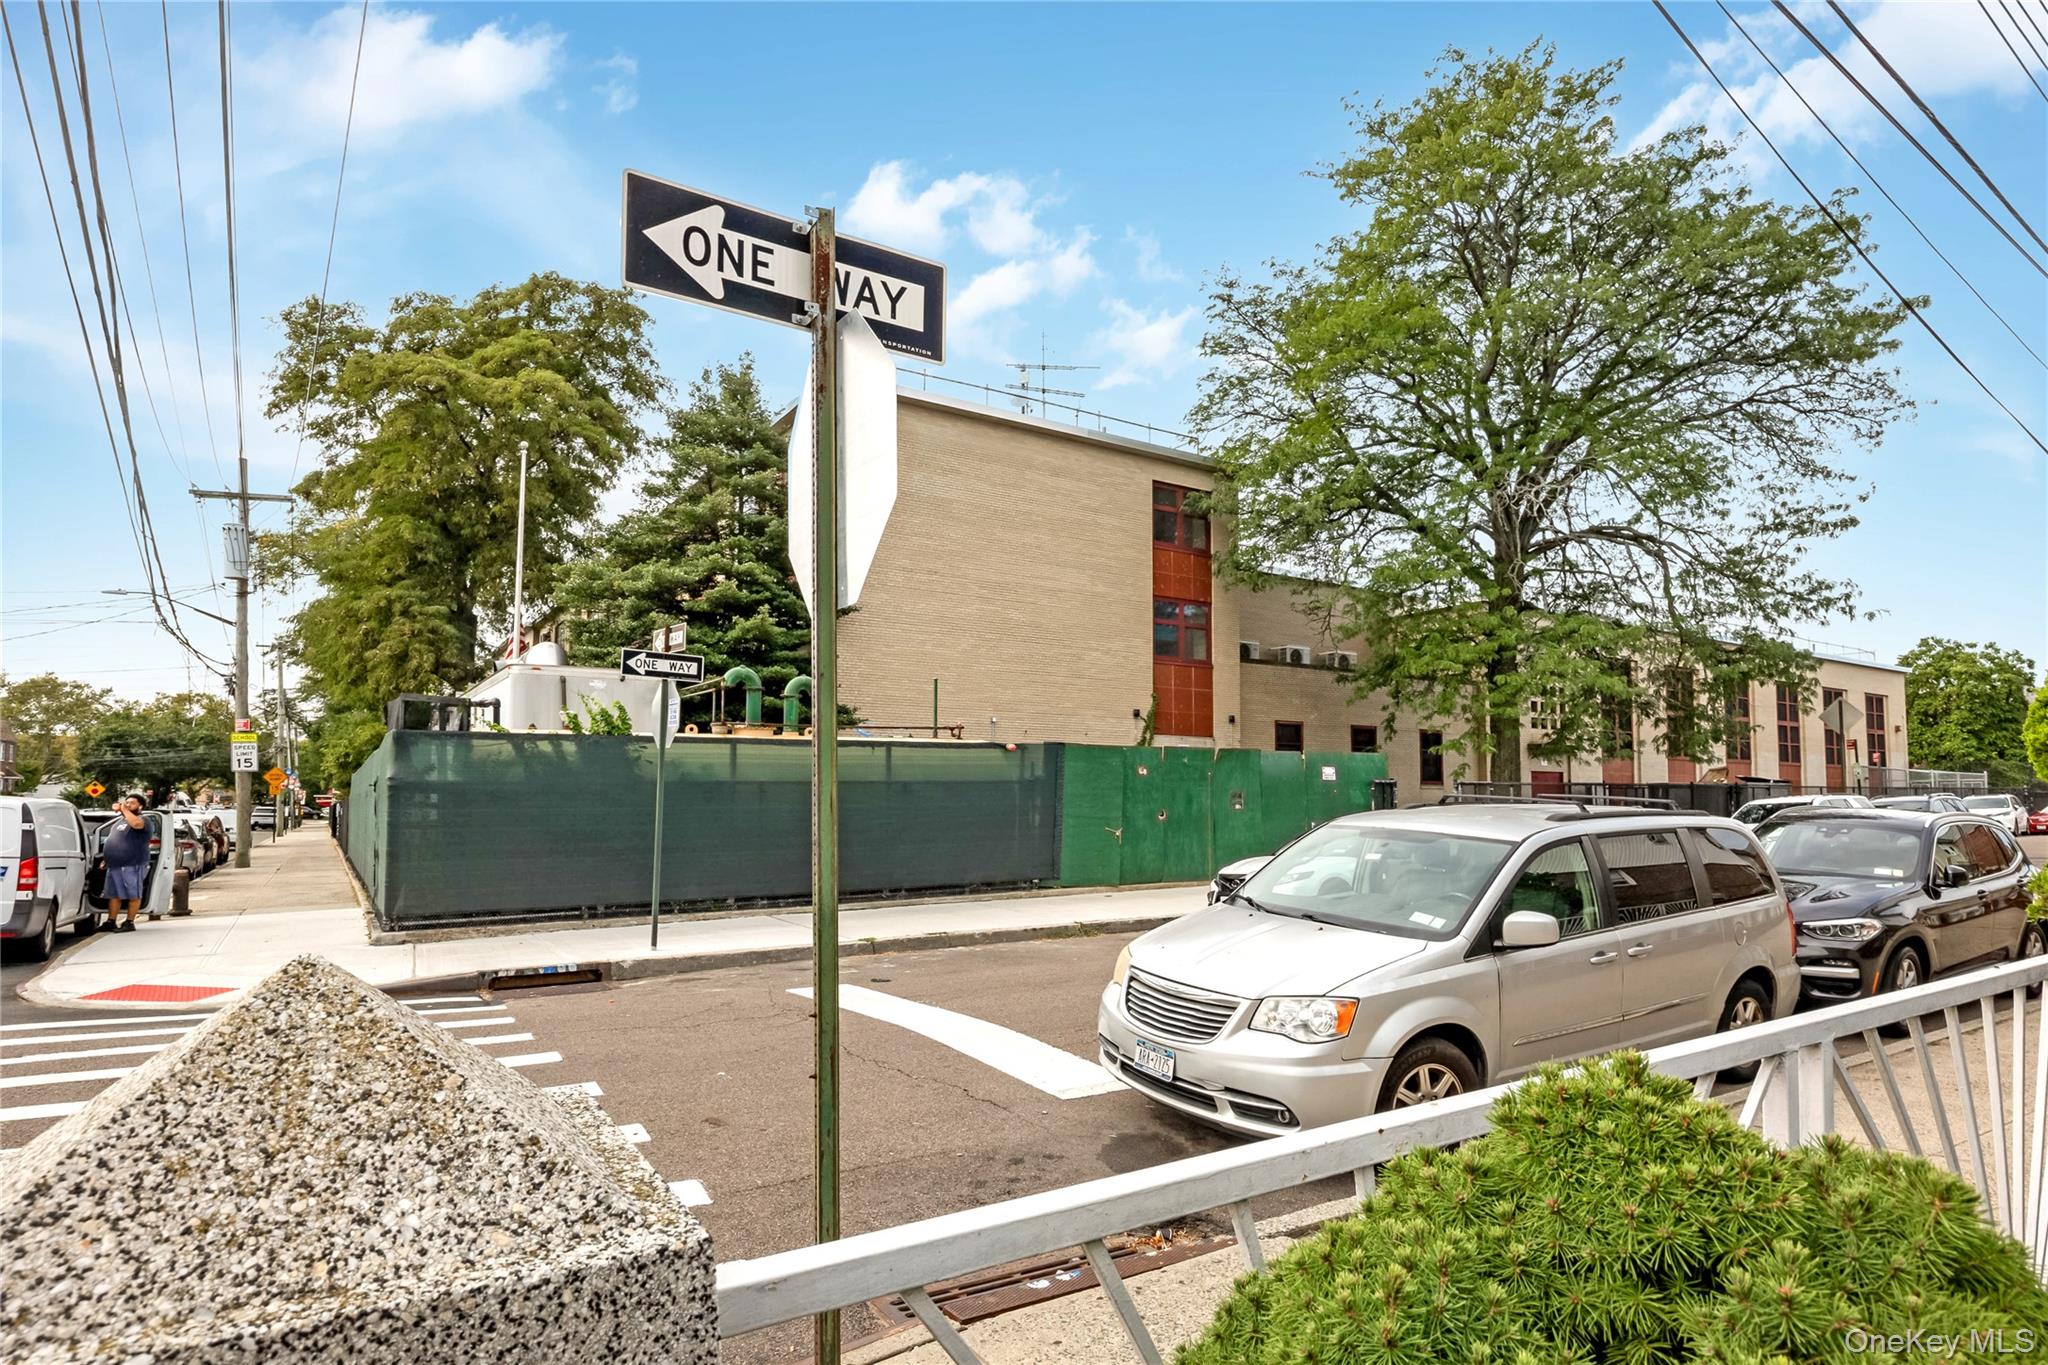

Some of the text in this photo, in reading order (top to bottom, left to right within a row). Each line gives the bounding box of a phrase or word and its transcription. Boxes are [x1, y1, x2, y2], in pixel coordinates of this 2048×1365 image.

[683, 226, 775, 287] ONE
[882, 339, 932, 356] NSPORTATION
[635, 658, 693, 673] ONE WAY
[237, 758, 253, 768] 15
